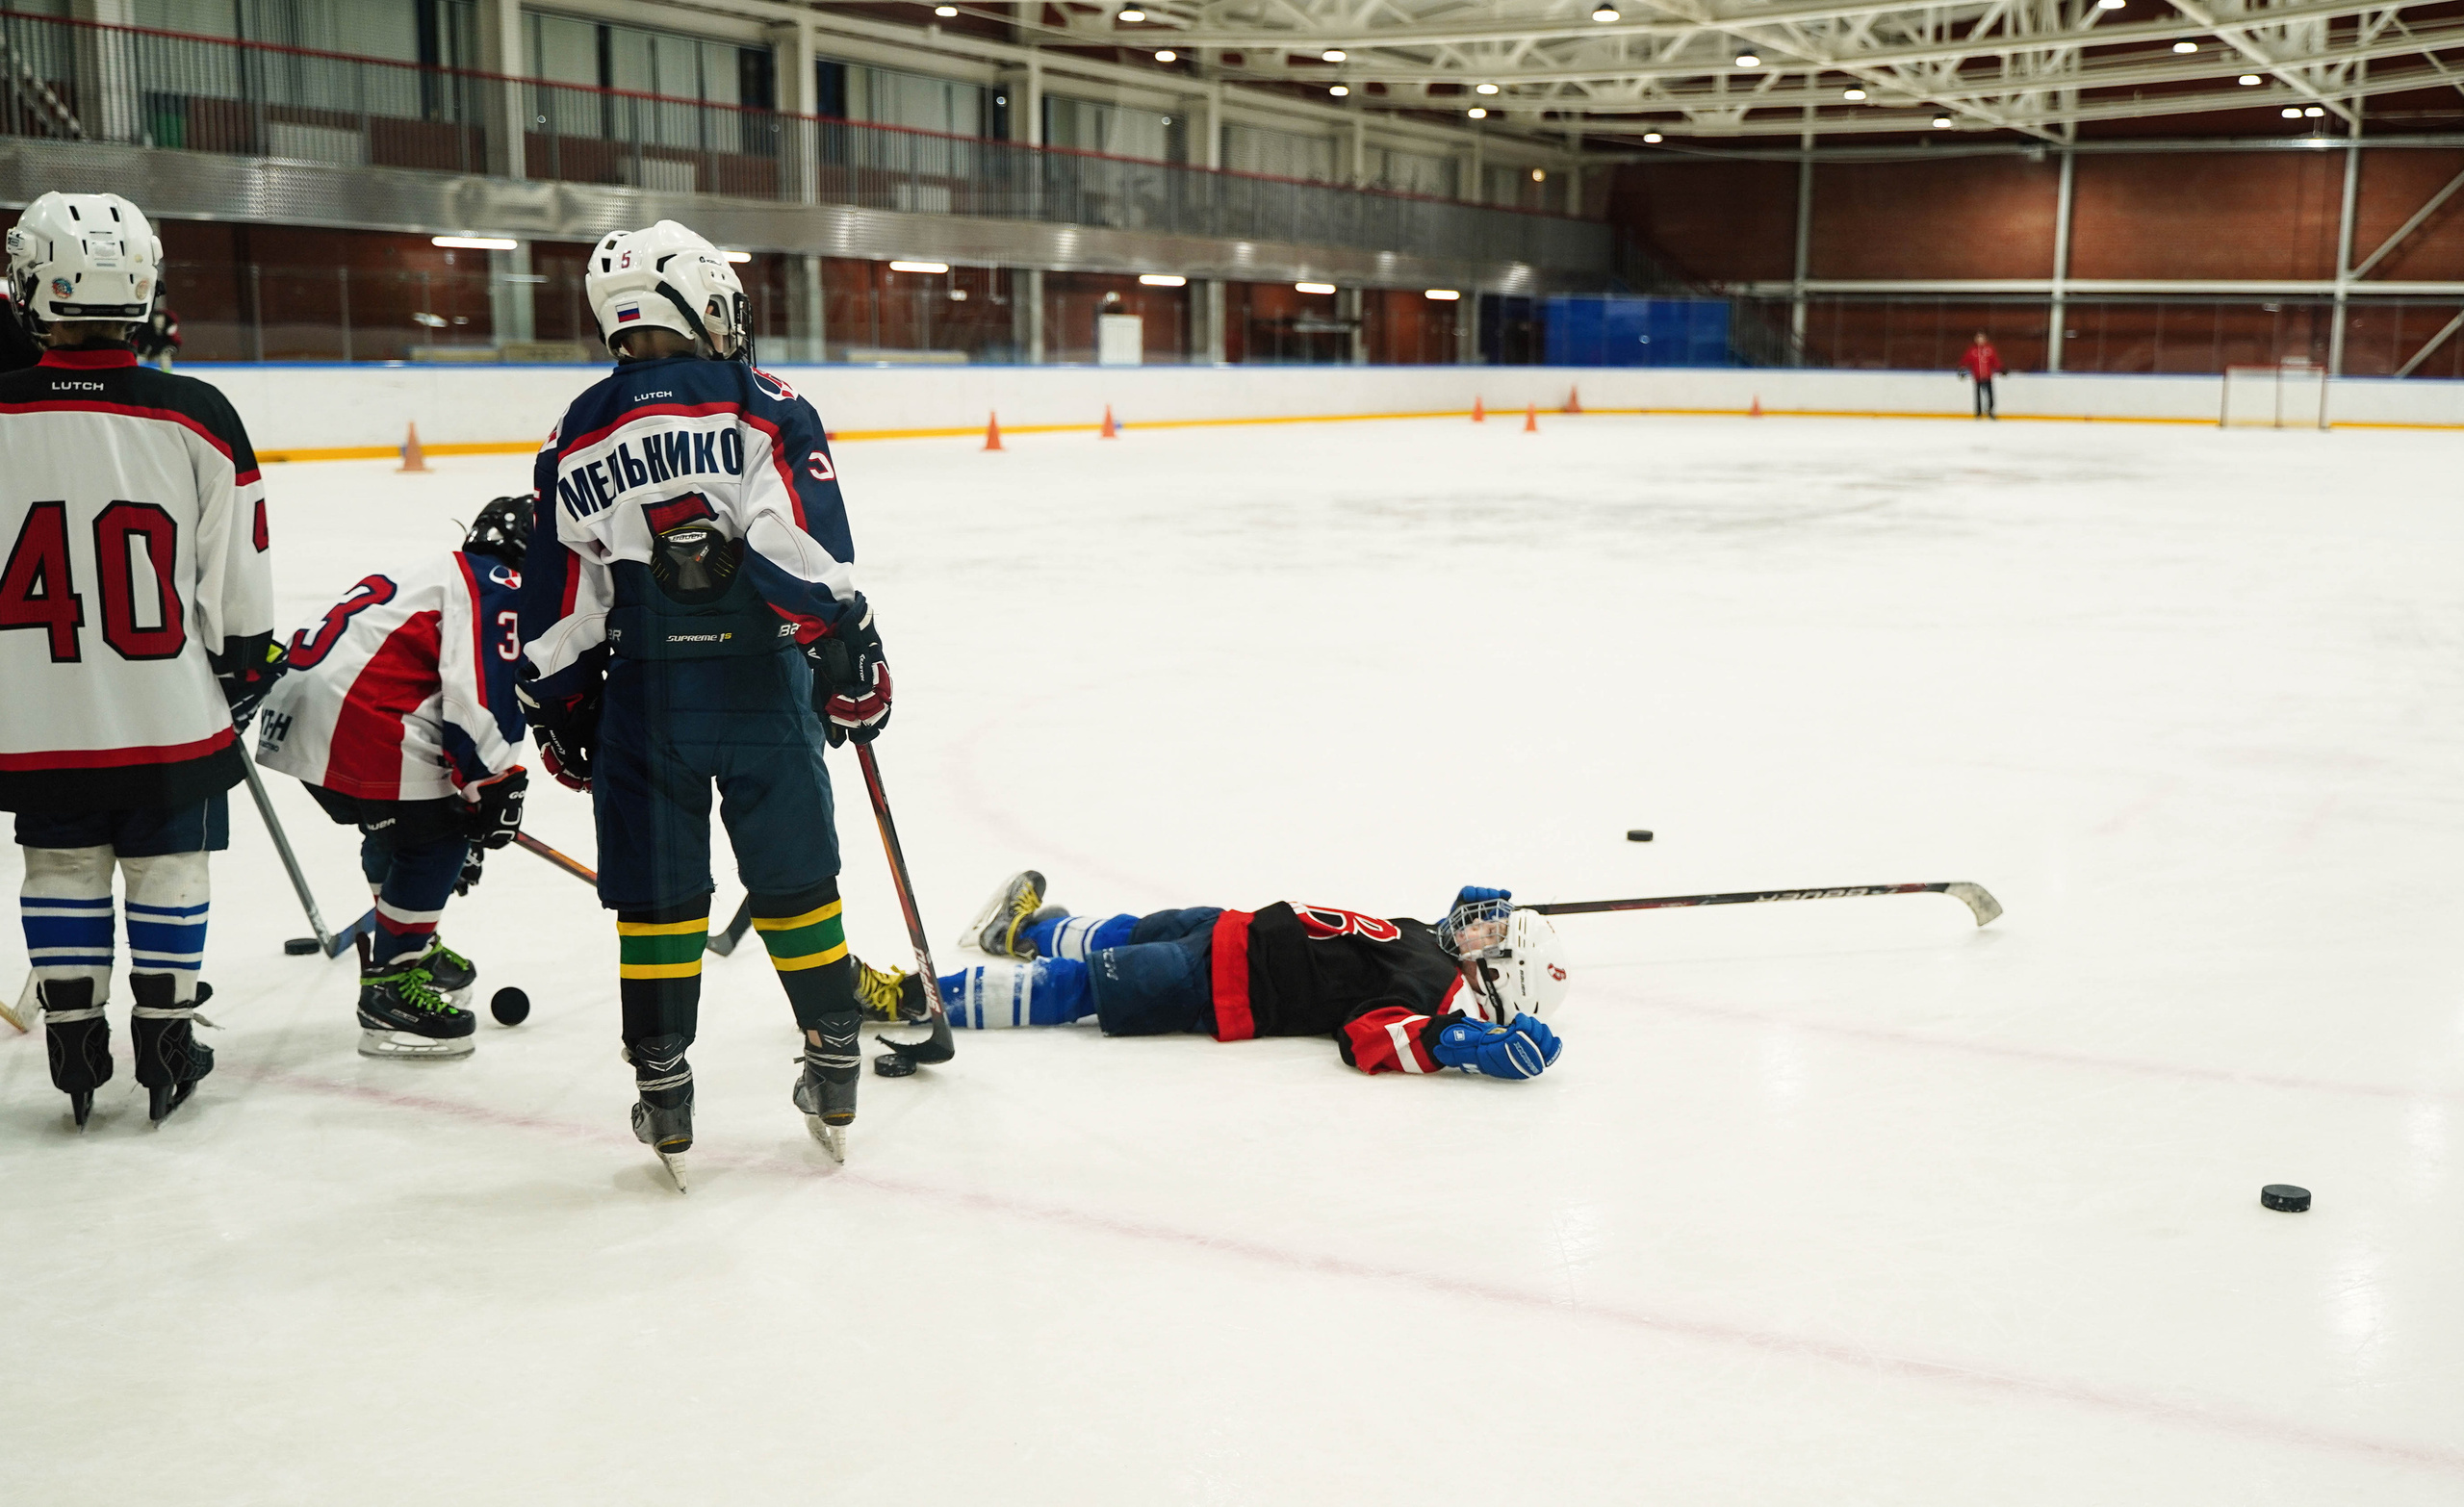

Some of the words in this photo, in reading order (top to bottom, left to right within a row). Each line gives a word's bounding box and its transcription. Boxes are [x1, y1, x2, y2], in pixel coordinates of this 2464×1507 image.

[621, 250, 631, 268] 5
[51, 381, 105, 392] LUTCH
[633, 390, 673, 402] LUTCH
[0, 499, 188, 664] 40
[287, 574, 398, 672] 3
[497, 610, 522, 662] 3
